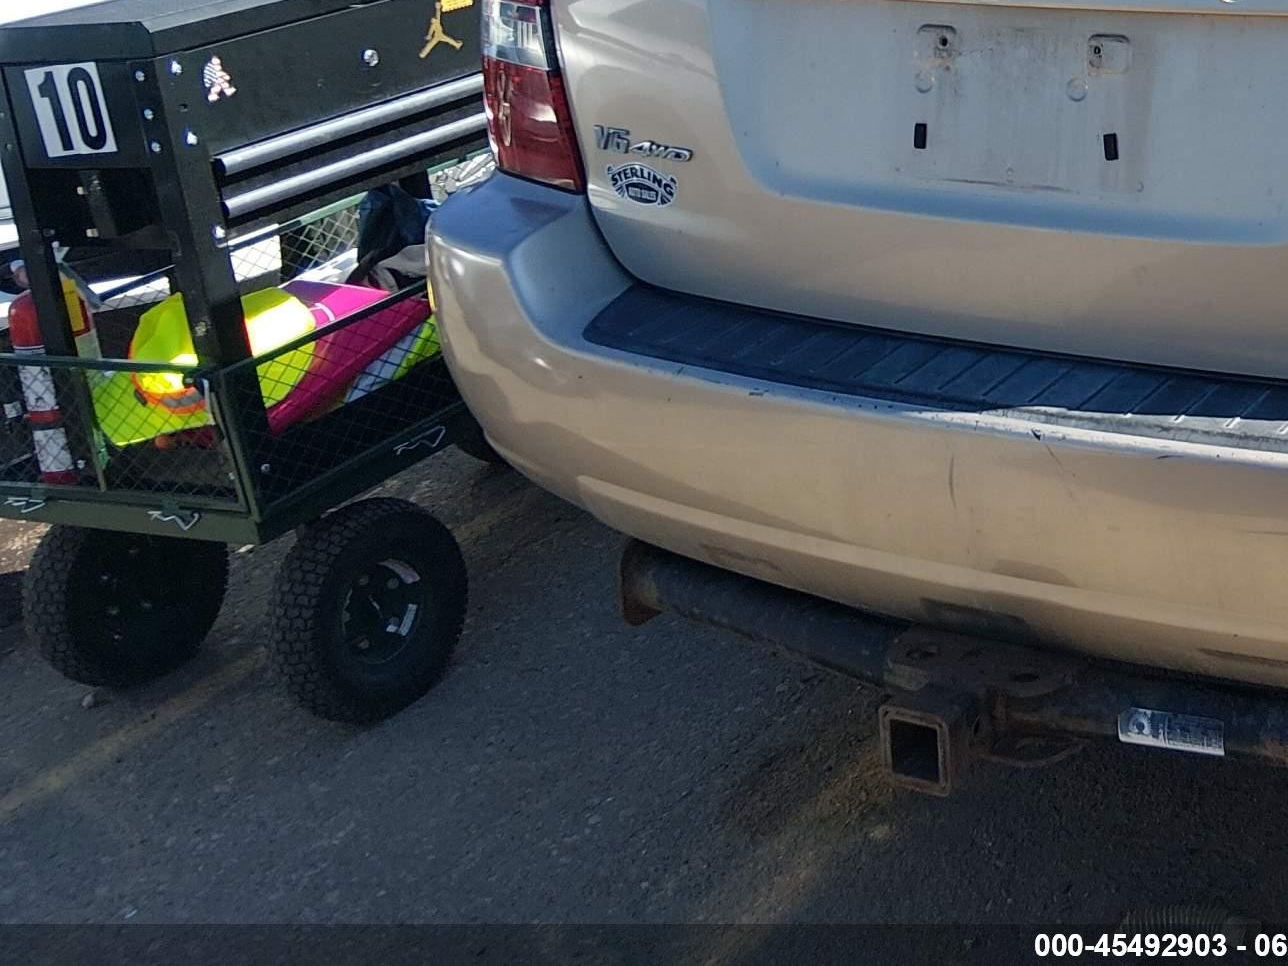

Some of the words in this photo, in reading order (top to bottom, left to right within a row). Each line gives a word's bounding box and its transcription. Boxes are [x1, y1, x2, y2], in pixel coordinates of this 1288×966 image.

[37, 66, 107, 151] 10
[593, 124, 630, 154] V6
[630, 140, 693, 162] 4WD
[611, 166, 675, 197] STERLING
